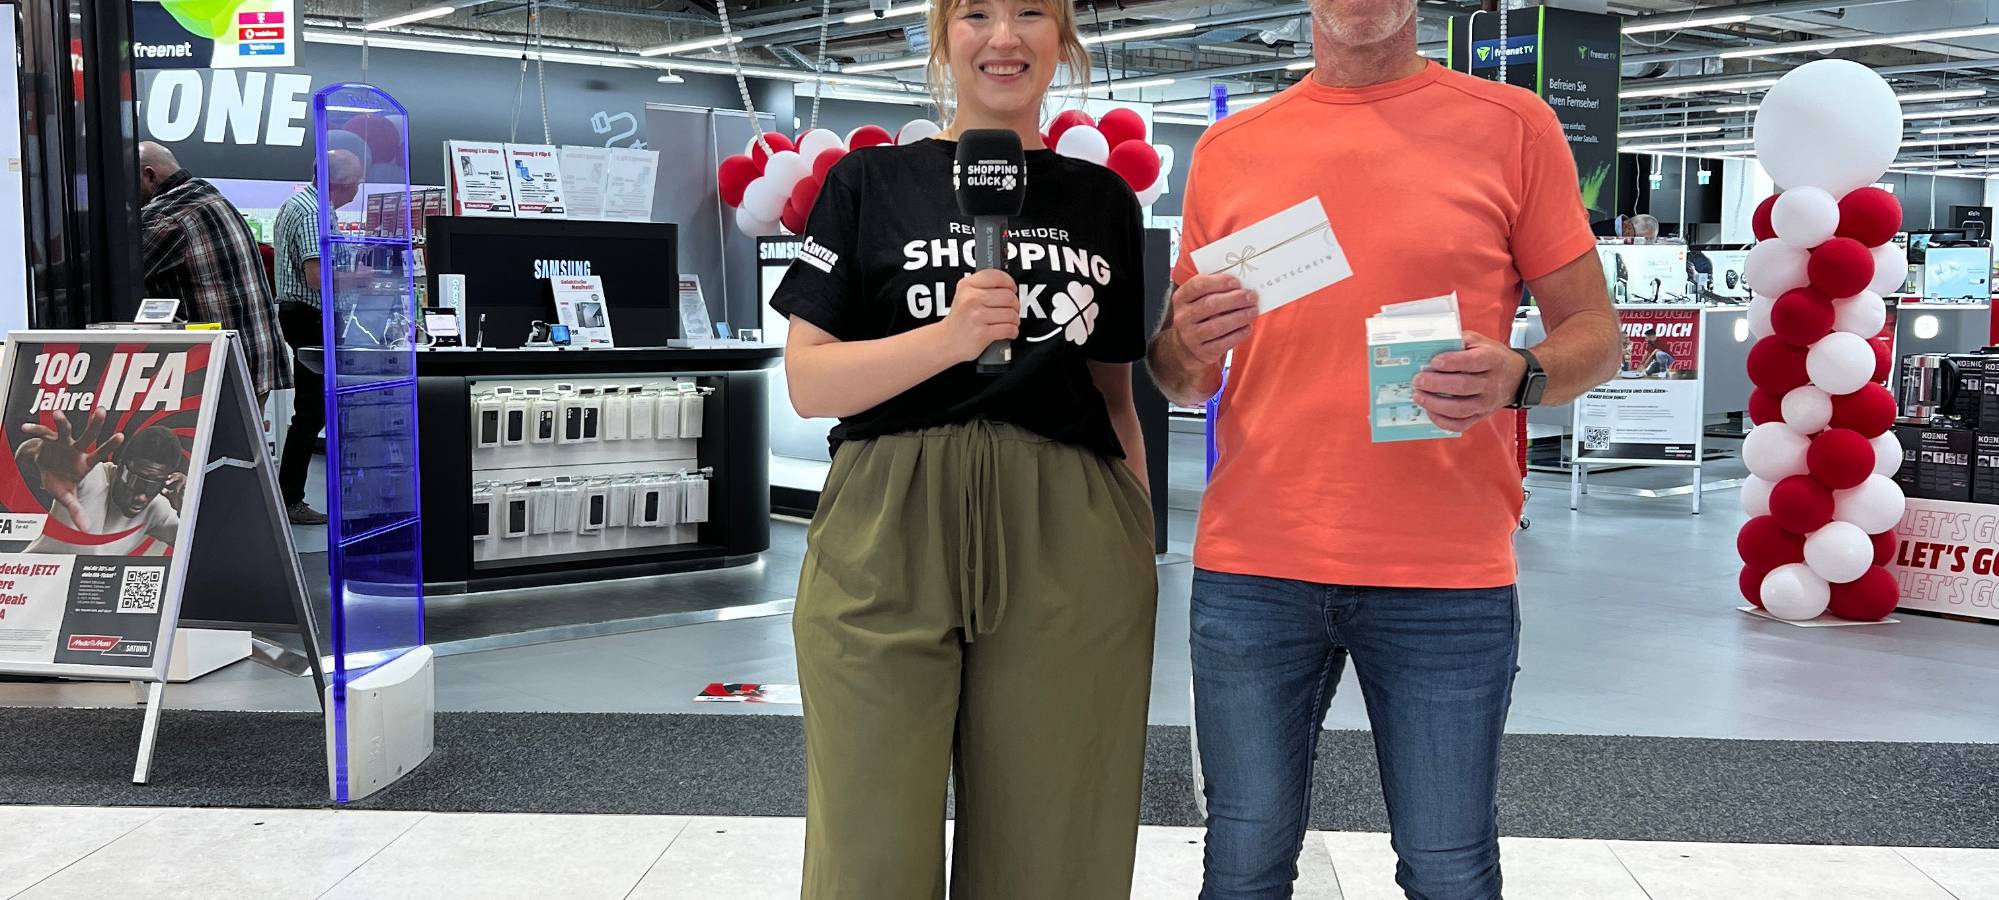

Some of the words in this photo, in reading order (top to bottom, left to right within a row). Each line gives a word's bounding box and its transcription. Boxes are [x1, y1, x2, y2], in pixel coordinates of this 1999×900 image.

[133, 41, 193, 58] freenet
[1523, 45, 1534, 54] TV
[1549, 78, 1576, 91] Befreien
[1577, 80, 1587, 93] Sie
[1549, 93, 1566, 107] Ihren
[1566, 95, 1600, 109] Fernseher!
[968, 165, 1018, 175] SHOPPING
[968, 174, 1002, 186] GLÜCK
[949, 222, 1069, 242] REHEIDER
[534, 259, 591, 279] SAMSUNG
[906, 272, 1047, 319] GLK
[1655, 323, 1693, 337] DICH
[32, 352, 91, 385] 100
[97, 351, 188, 412] IFA
[29, 387, 95, 415] Jahre
[1898, 508, 1972, 541] LET'S
[1896, 540, 1970, 573] LET'S
[30, 564, 60, 576] JETZT
[1899, 571, 1969, 604] LET'S
[126, 645, 148, 653] SATURN
